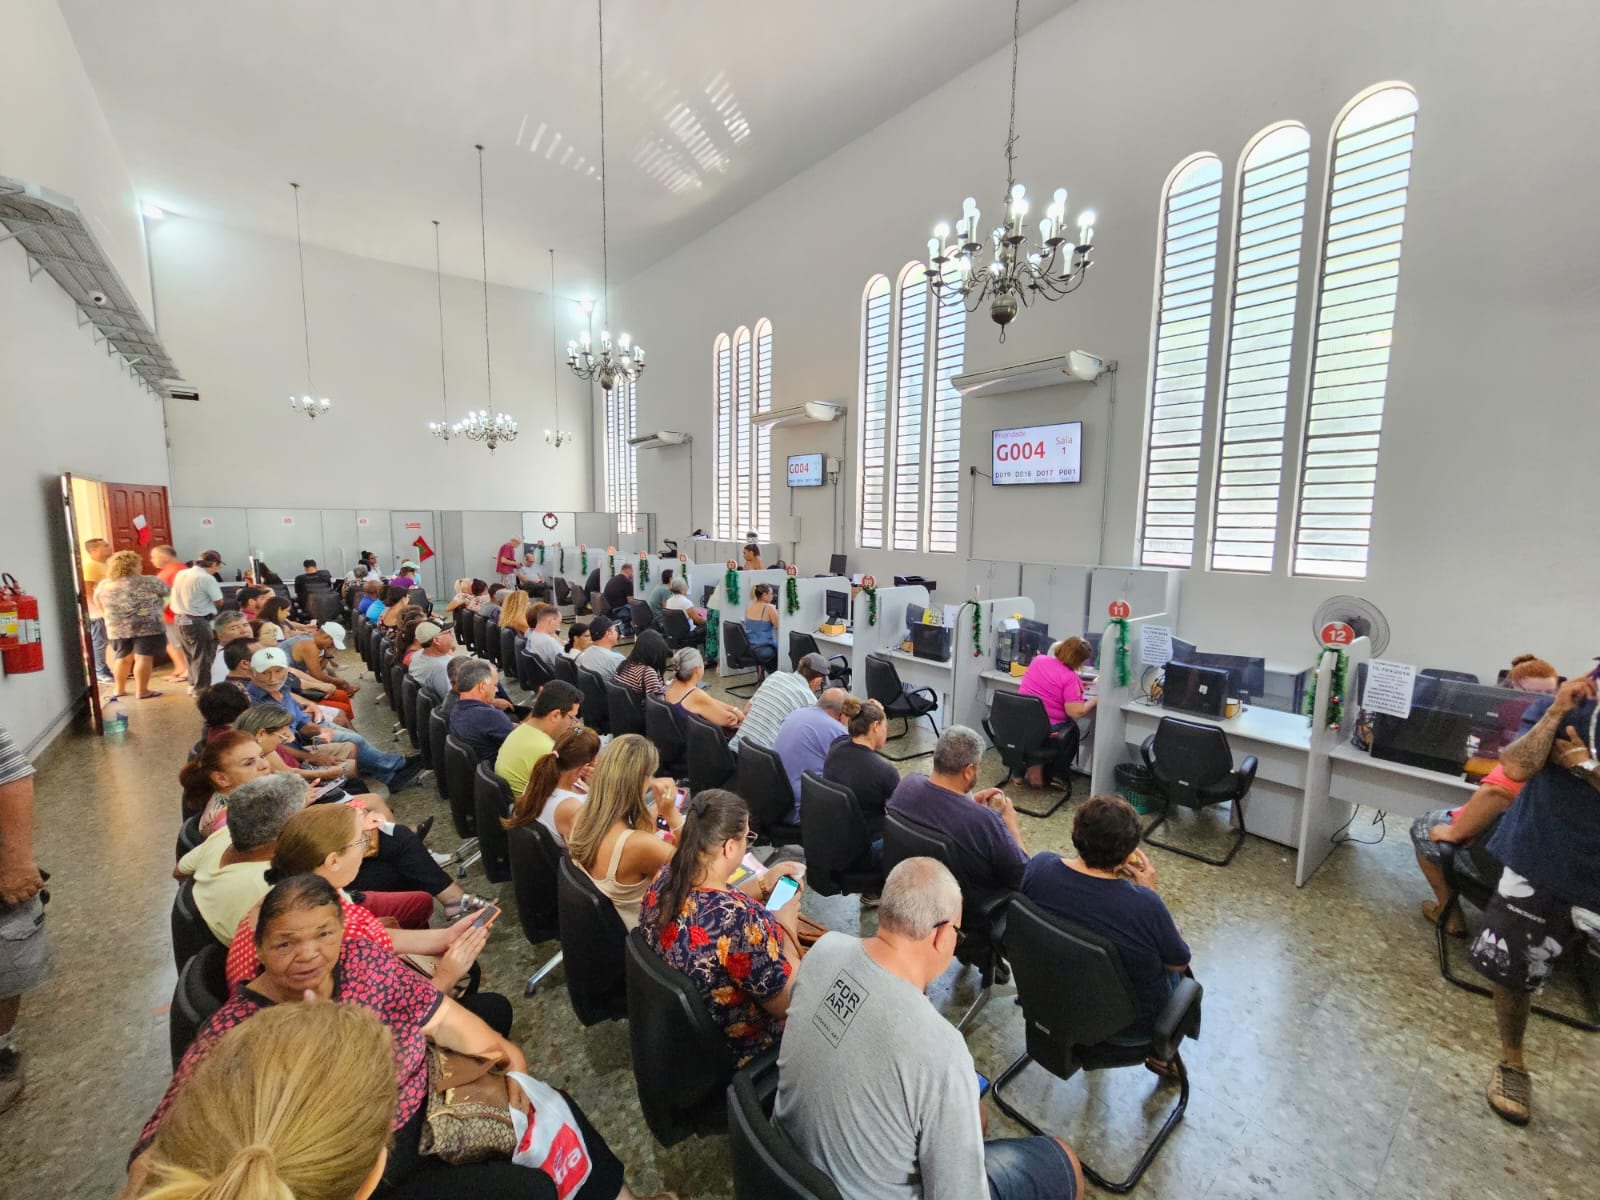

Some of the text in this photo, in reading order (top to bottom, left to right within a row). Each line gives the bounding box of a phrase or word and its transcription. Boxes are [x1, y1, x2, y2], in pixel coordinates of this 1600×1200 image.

[1056, 436, 1073, 446] Sala
[996, 441, 1045, 462] G004
[1062, 447, 1066, 455] 1
[789, 463, 809, 474] G004
[1113, 606, 1124, 616] 11
[1328, 630, 1347, 642] 12
[826, 993, 853, 1019] ART
